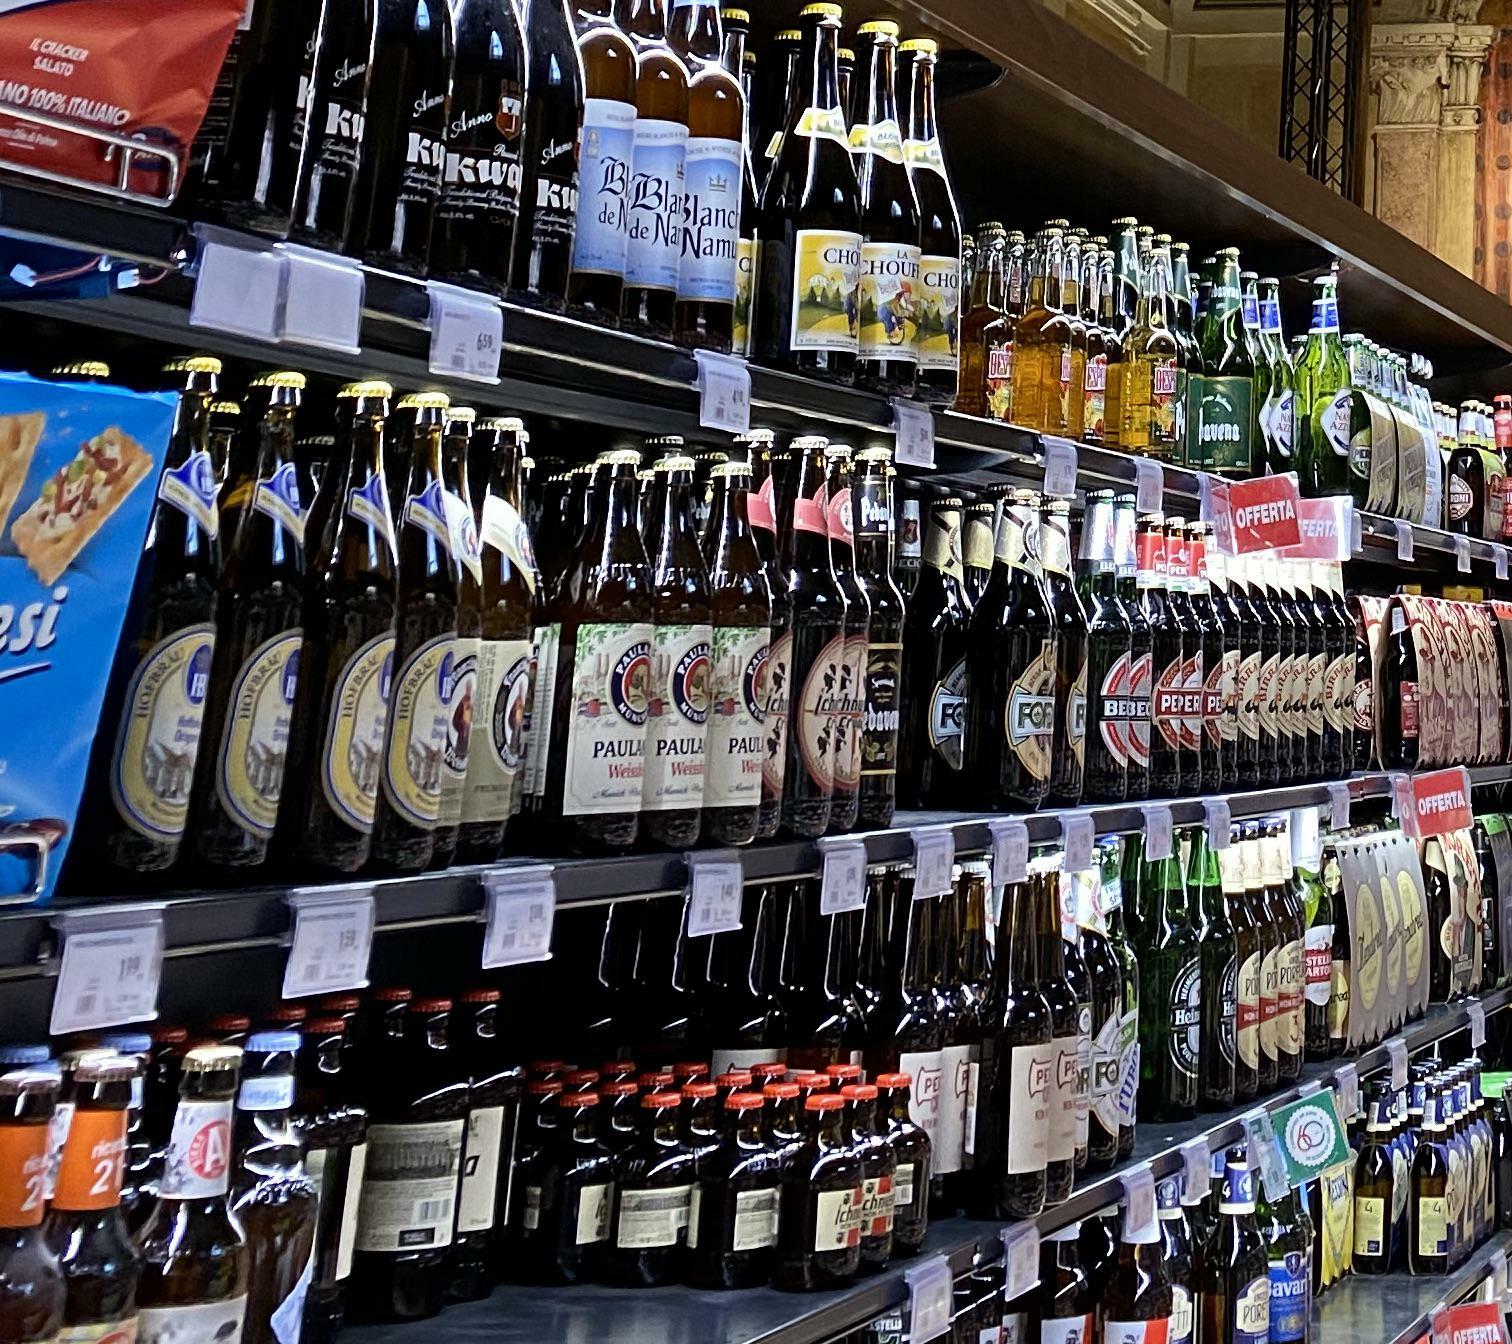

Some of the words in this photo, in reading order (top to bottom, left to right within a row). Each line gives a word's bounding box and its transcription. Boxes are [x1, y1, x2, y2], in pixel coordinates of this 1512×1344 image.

[41, 40, 89, 63] CRACKER
[33, 56, 75, 77] SALATO
[30, 85, 67, 114] 100%
[66, 96, 131, 126] ITALIANO
[450, 109, 493, 139] Anno
[629, 217, 649, 240] de
[1235, 499, 1297, 529] OFFERTA
[1418, 789, 1467, 816] OFFERTA
[1305, 953, 1333, 967] STELL
[1305, 965, 1330, 978] ARTO
